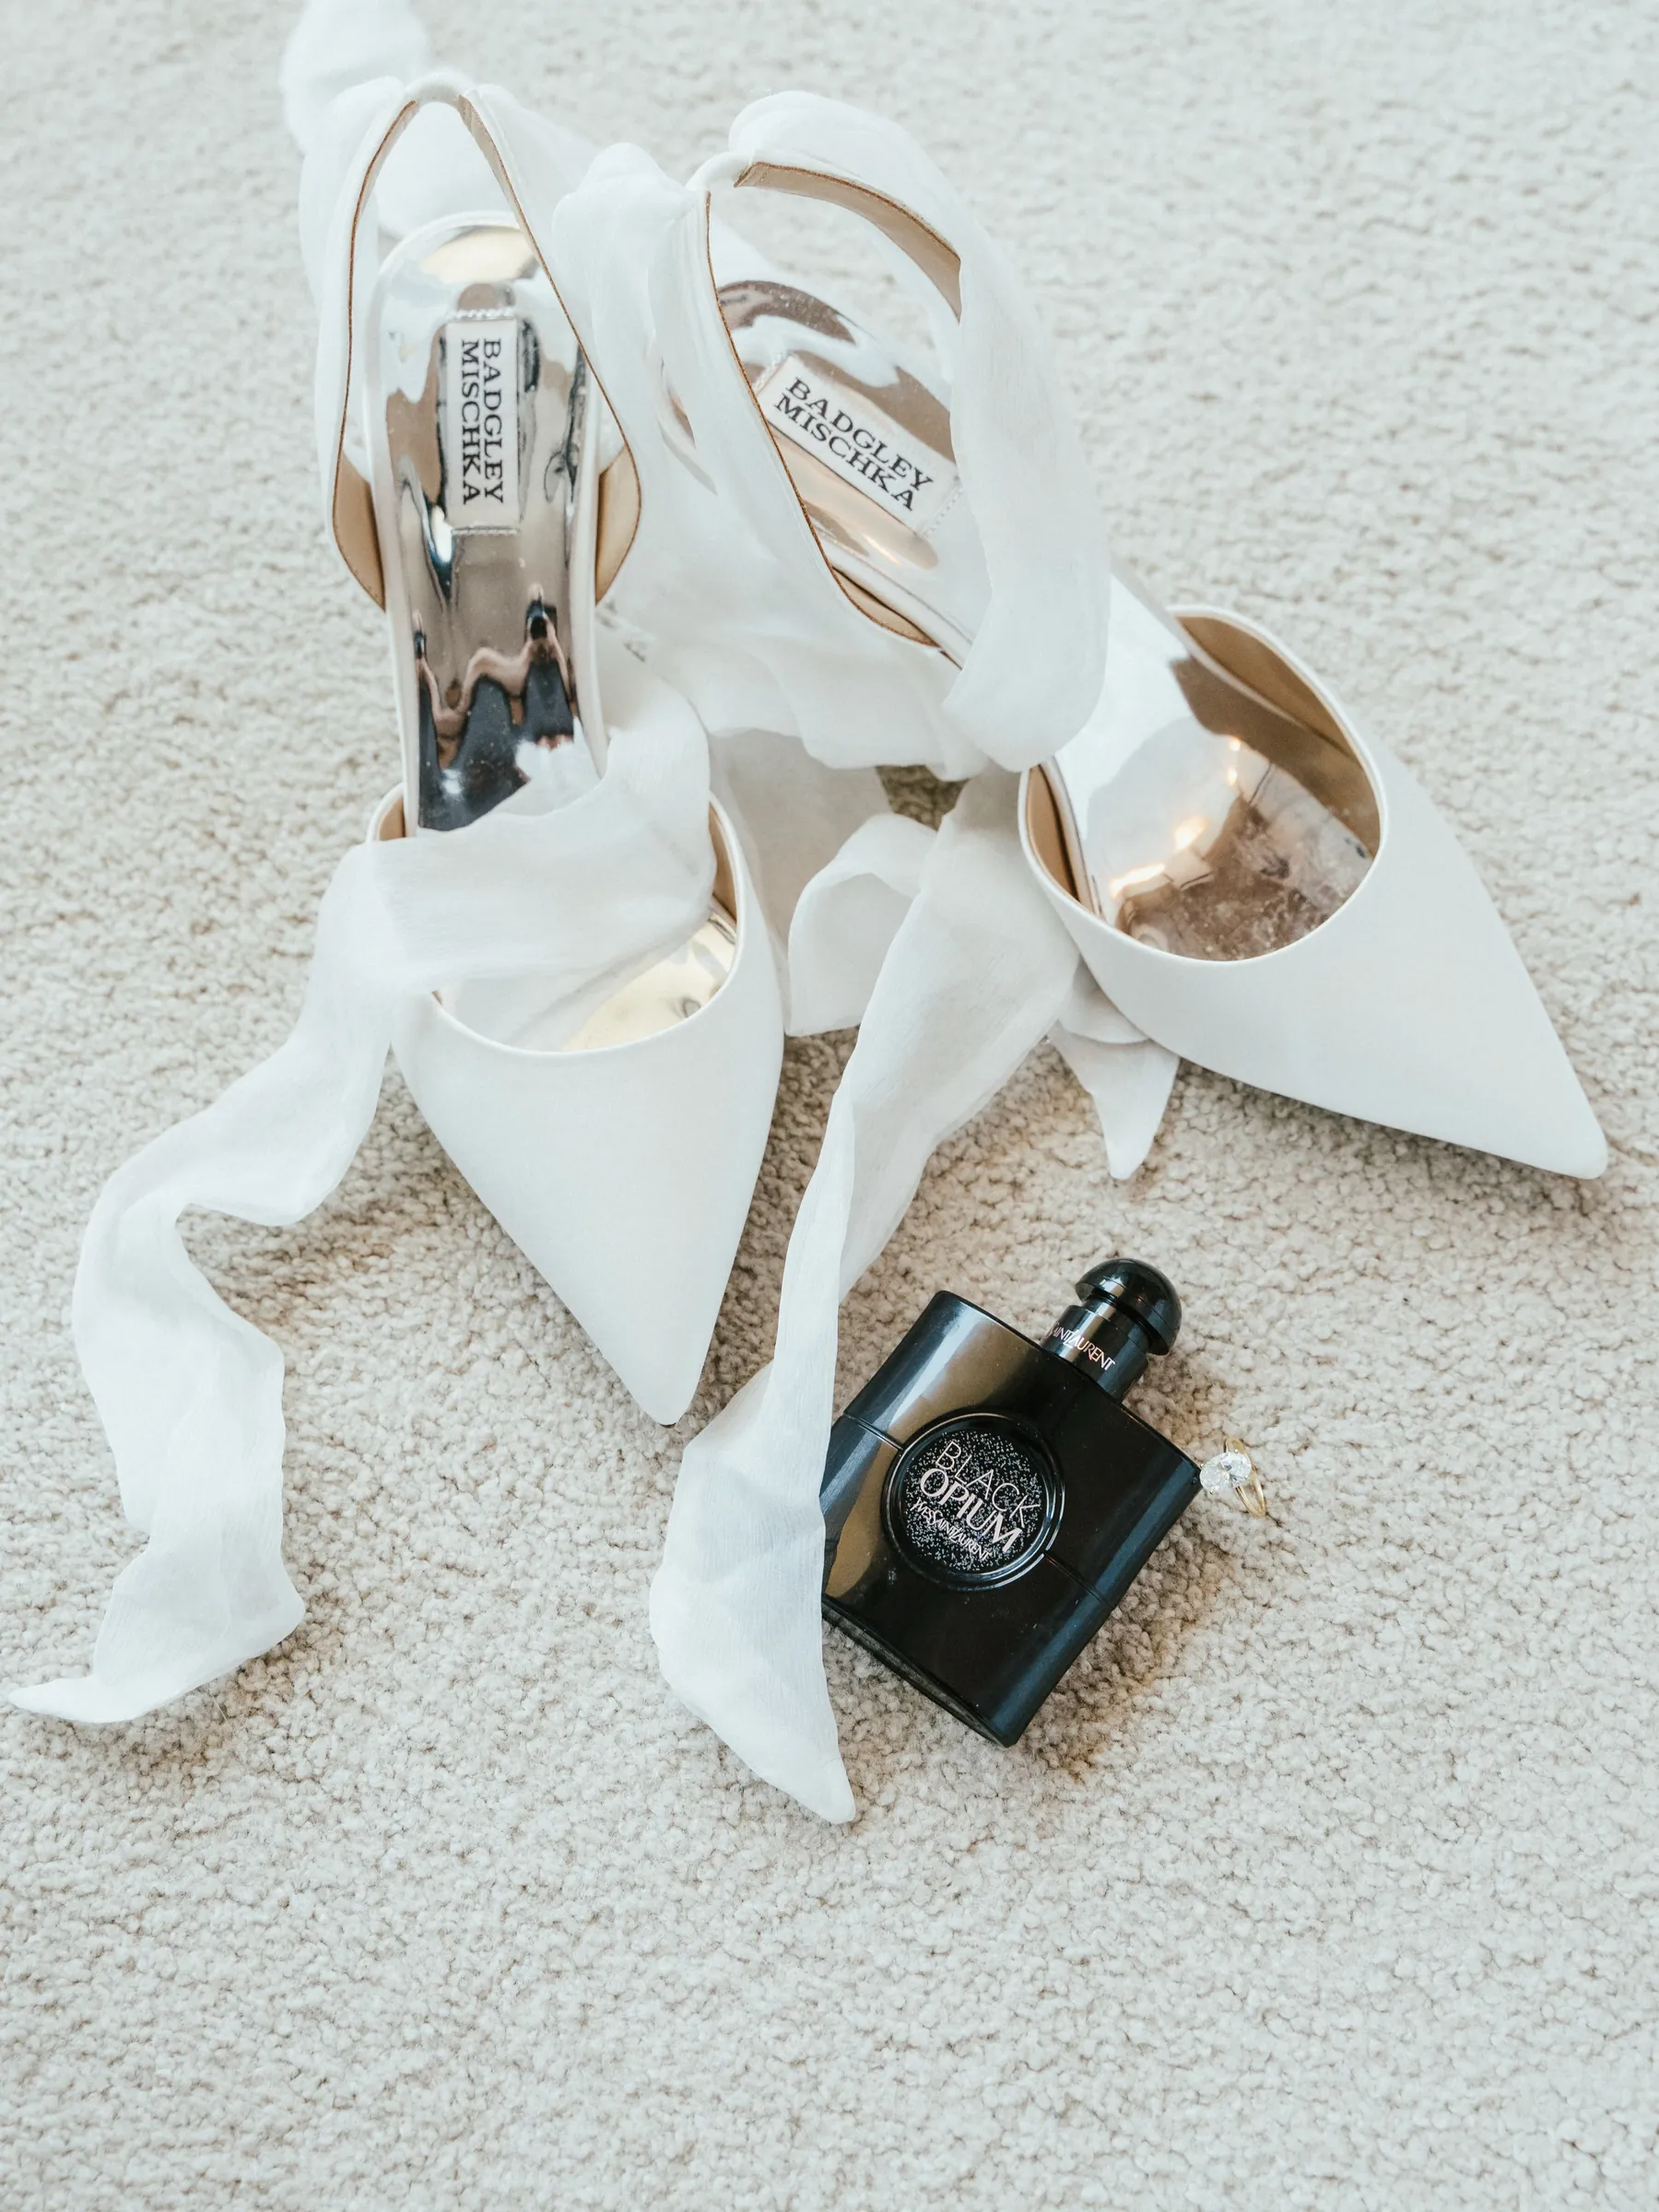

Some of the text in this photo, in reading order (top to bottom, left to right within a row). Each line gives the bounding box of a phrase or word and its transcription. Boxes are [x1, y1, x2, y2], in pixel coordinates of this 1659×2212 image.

[461, 339, 481, 505] MISCHKA
[483, 338, 504, 503] BADGLEY
[773, 394, 913, 512] MISCHKA
[785, 377, 934, 491] BADGLEY
[920, 1467, 1023, 1553] OPIUM
[935, 1441, 1041, 1529] BLACK
